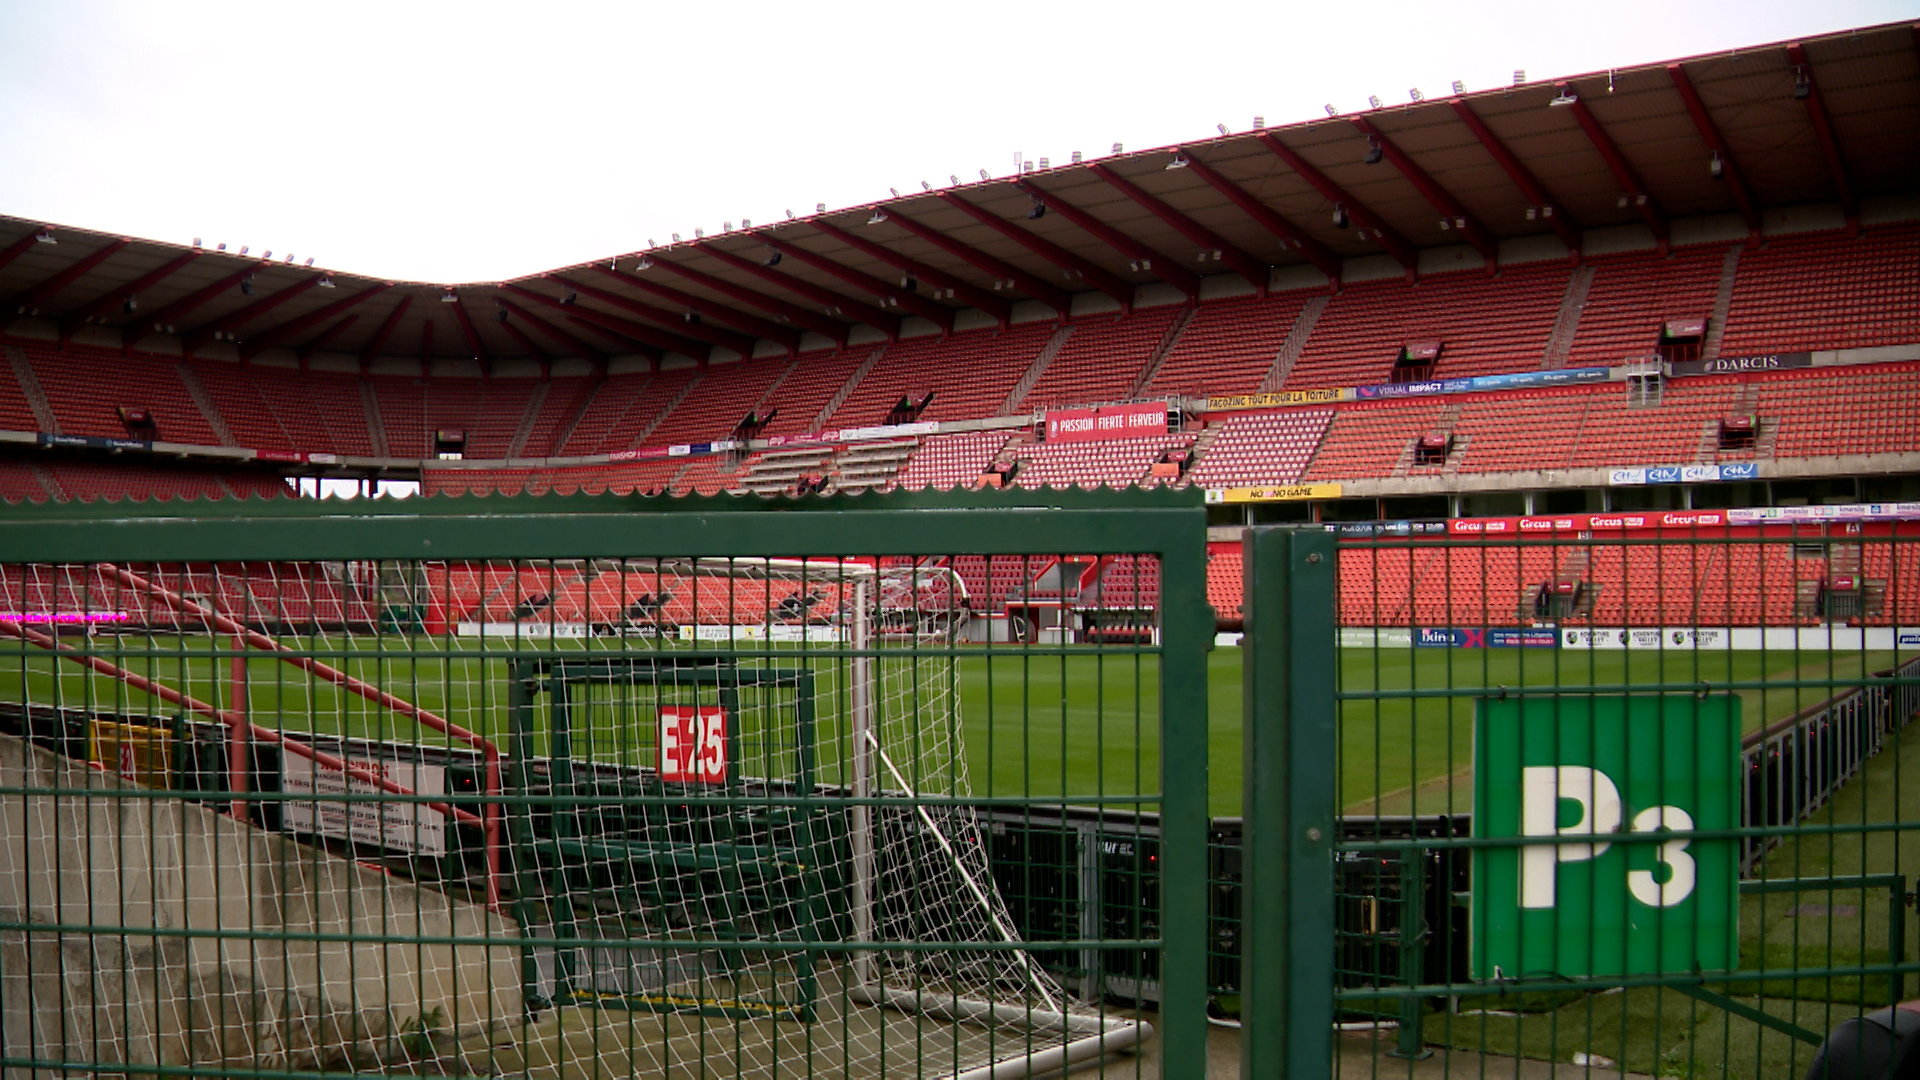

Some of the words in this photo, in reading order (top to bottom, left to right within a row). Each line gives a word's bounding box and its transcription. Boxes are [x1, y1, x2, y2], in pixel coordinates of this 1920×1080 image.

[1716, 355, 1779, 370] DARCIS
[1060, 417, 1094, 432] PASSION
[1129, 411, 1164, 428] FERVEUR
[1520, 519, 1551, 529] Circus
[1590, 516, 1622, 526] Circus
